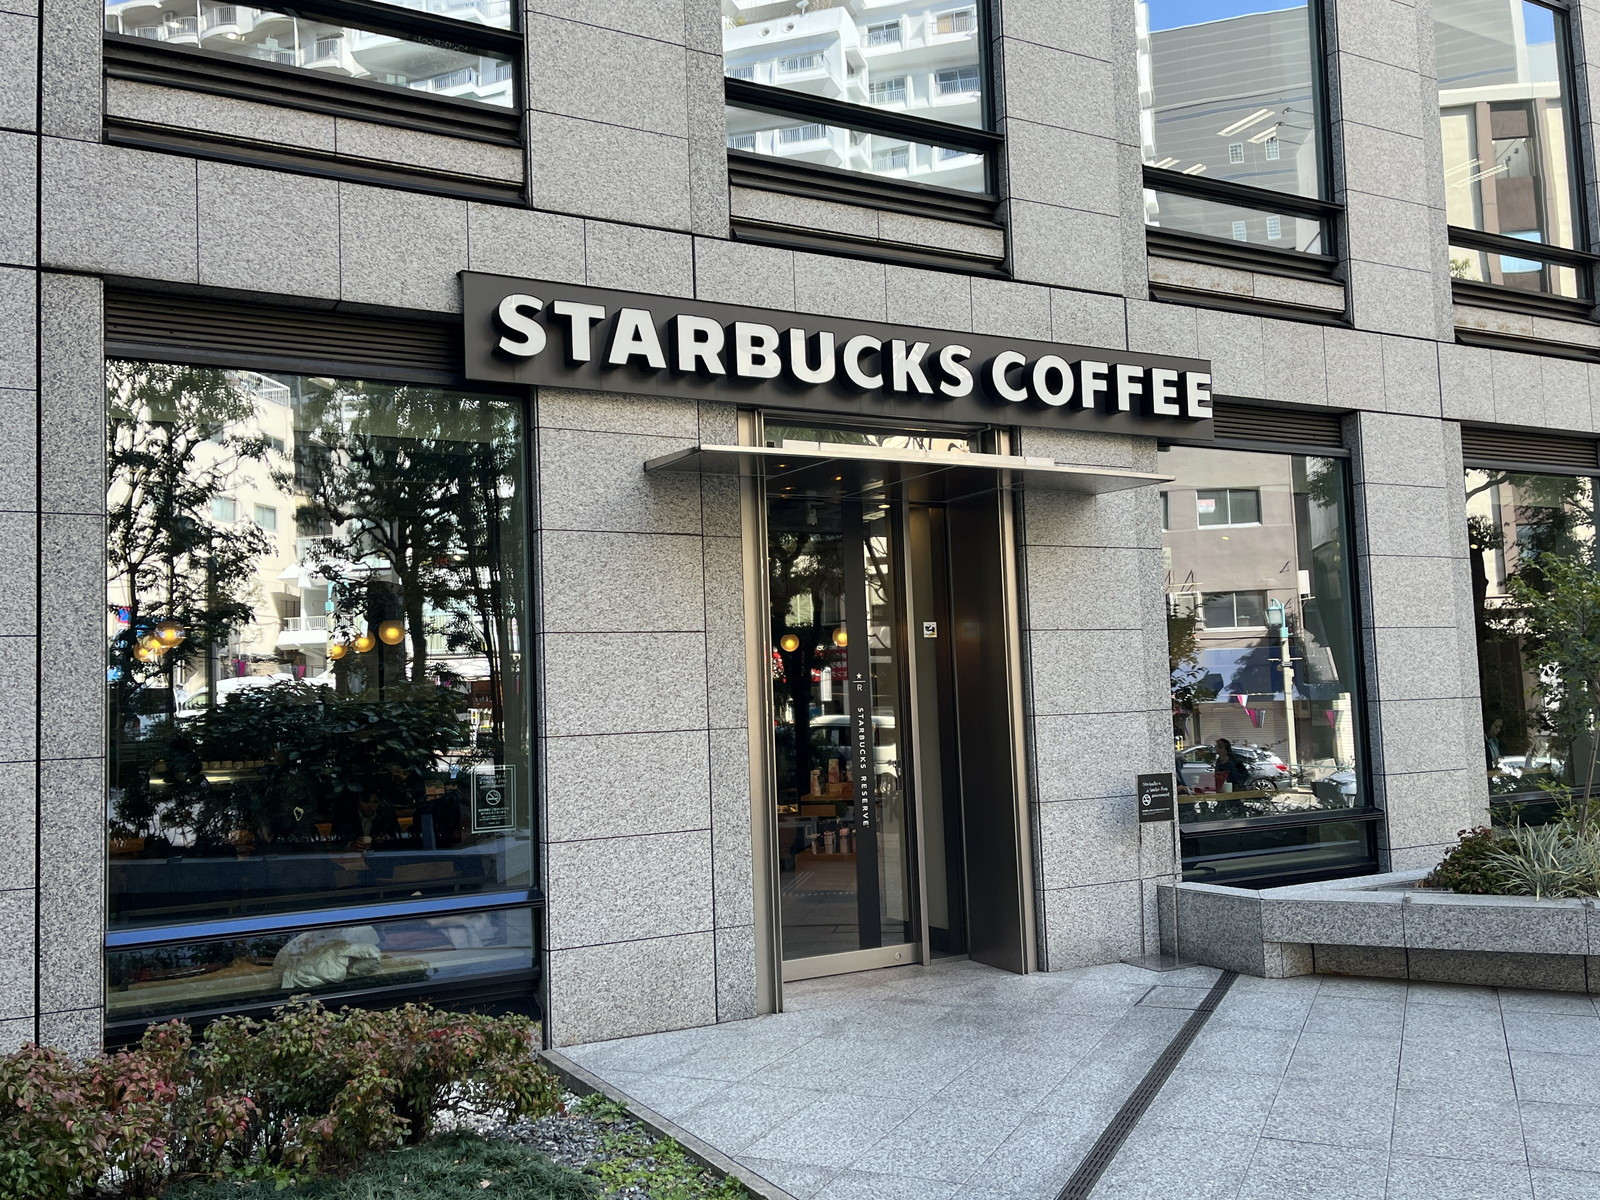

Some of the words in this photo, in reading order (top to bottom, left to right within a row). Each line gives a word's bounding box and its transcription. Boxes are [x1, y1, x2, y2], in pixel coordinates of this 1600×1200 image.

[498, 294, 974, 398] STARBUCKS
[992, 350, 1213, 419] COFFEE
[856, 684, 863, 692] R
[857, 707, 867, 769] STARBUCKS
[860, 775, 870, 826] RESERVE
